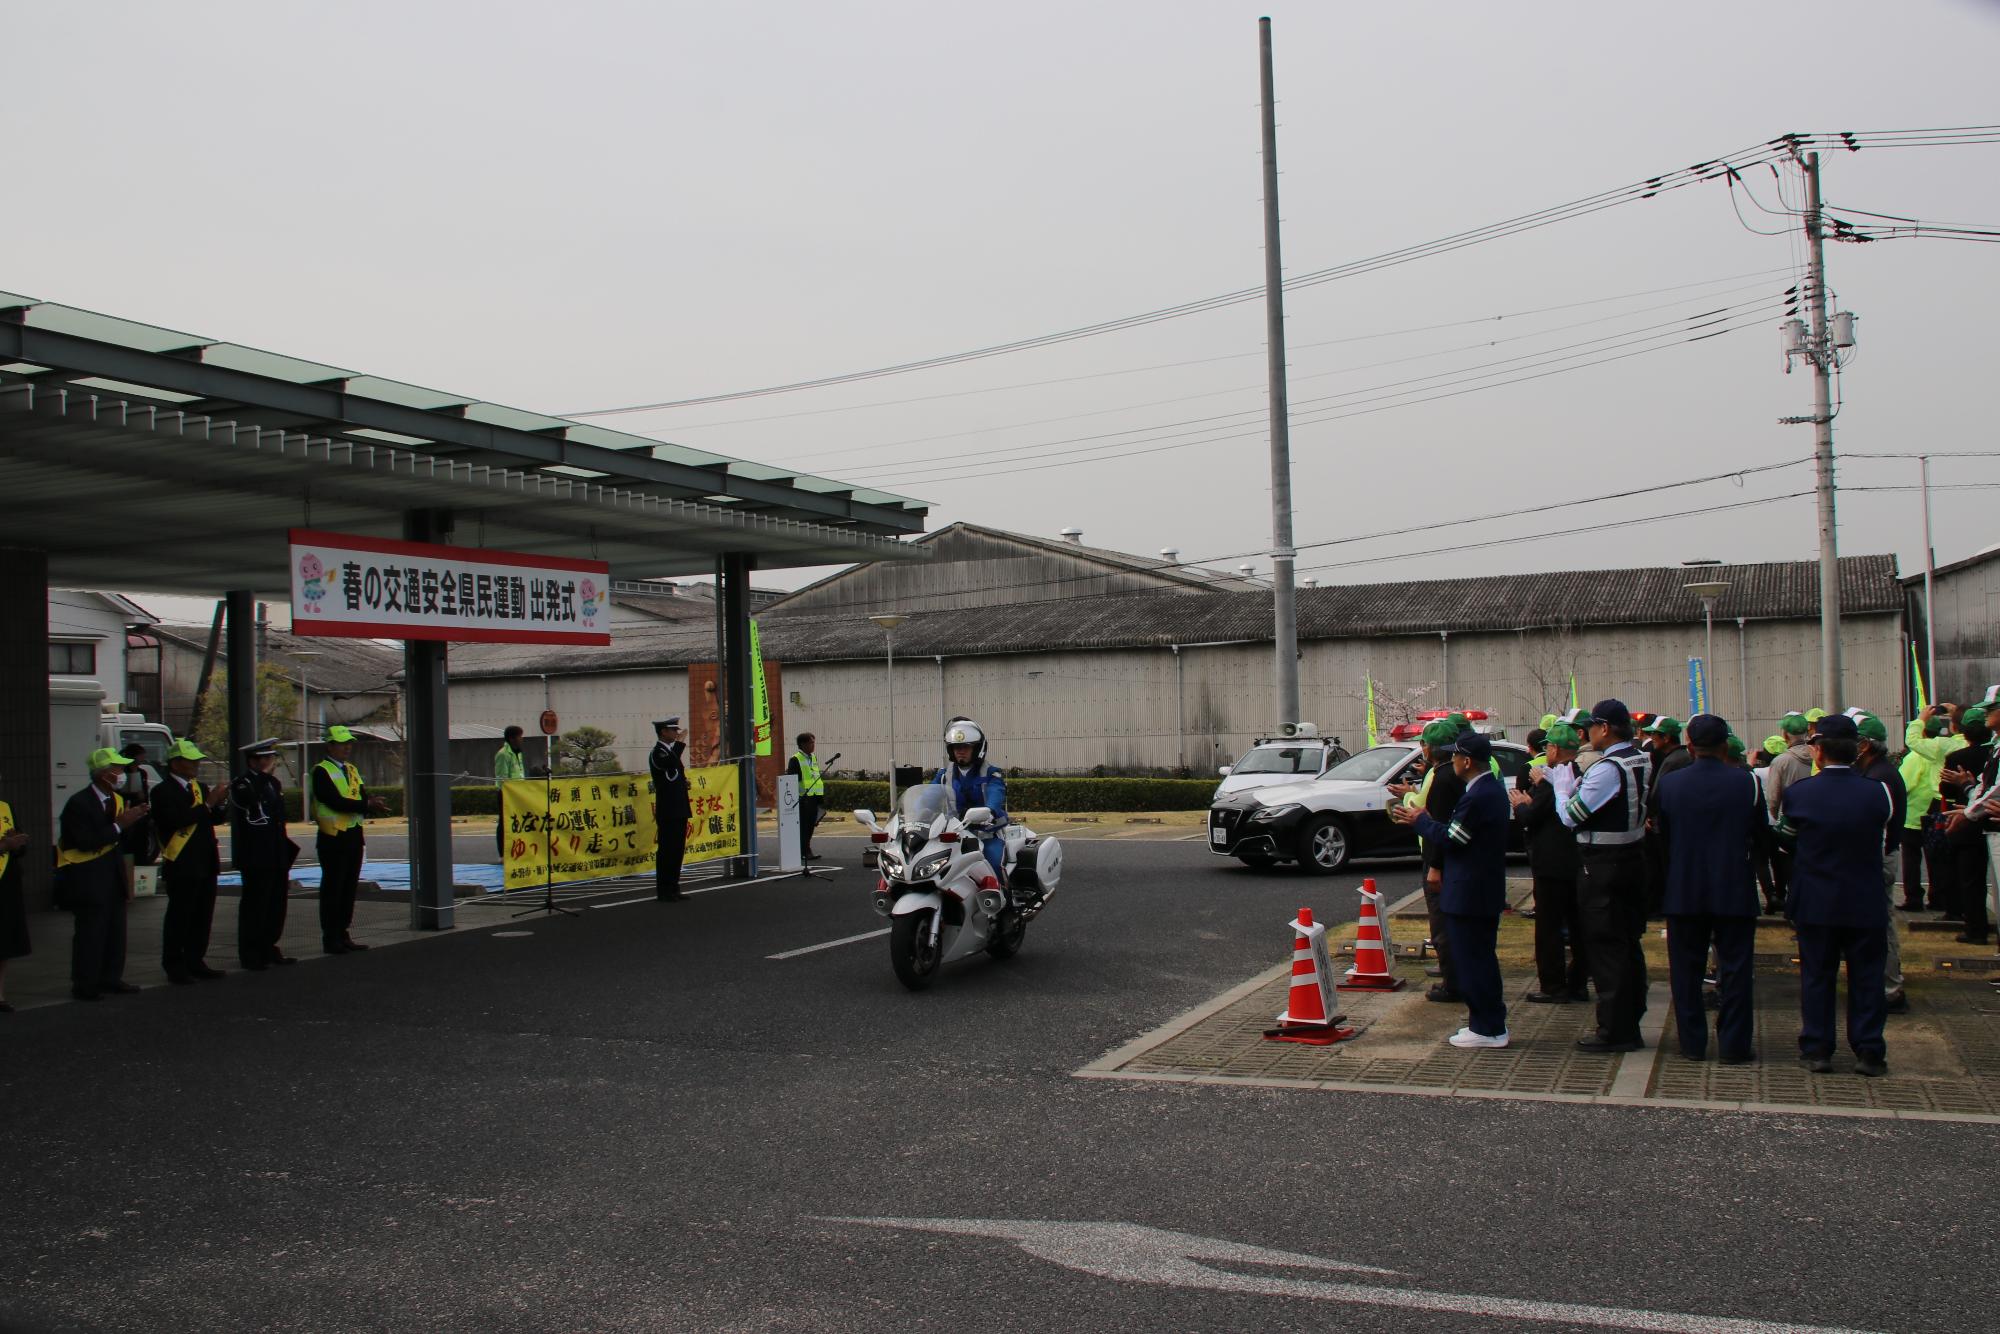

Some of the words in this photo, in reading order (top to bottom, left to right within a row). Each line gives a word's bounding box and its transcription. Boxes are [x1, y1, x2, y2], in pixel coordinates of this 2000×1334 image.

[343, 561, 526, 620] 春の交通安全県民運動
[531, 577, 576, 623] 出発式
[511, 830, 636, 861] ゆっくり走って
